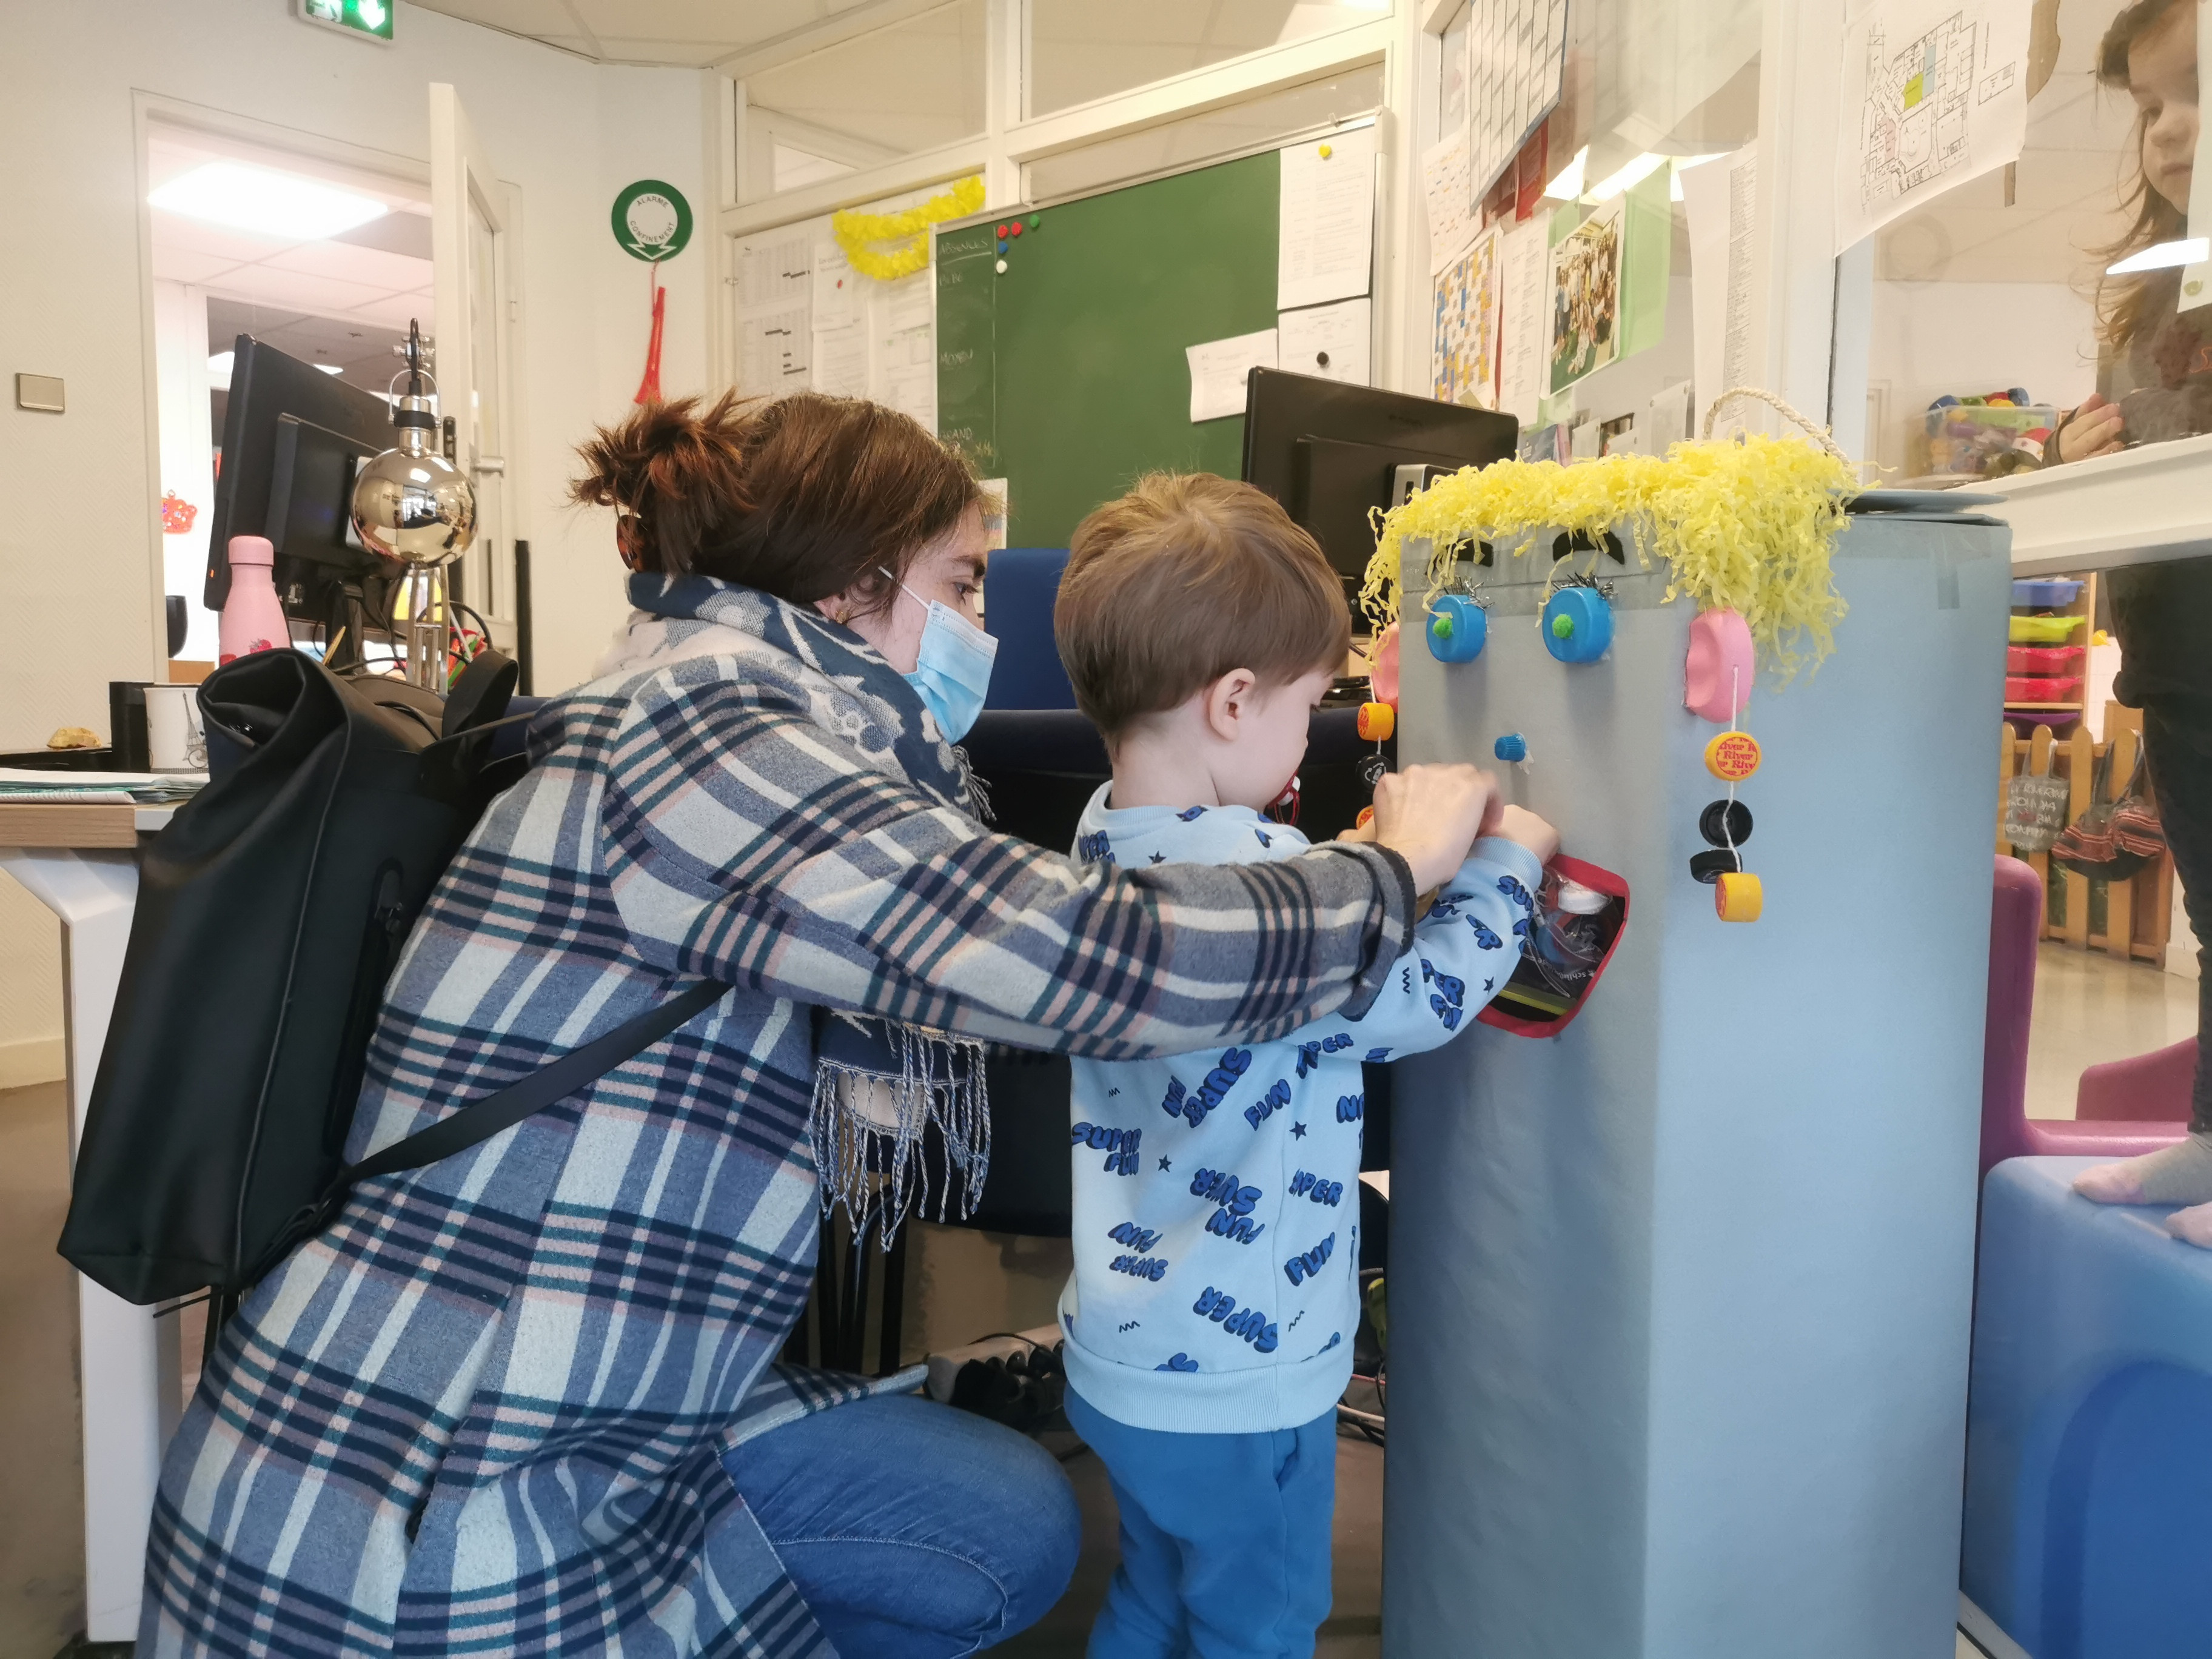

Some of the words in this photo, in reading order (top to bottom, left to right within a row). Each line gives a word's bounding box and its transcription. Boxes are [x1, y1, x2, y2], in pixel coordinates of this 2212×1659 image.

[637, 196, 669, 209] ALARME
[630, 220, 674, 243] CONFINEMENT
[1724, 750, 1754, 760] River
[1732, 760, 1755, 769] Rive
[1244, 1079, 1292, 1131] FUN
[1071, 1122, 1142, 1155] SUPER
[1104, 1152, 1140, 1176] FUN
[1107, 1221, 1164, 1254] FUN
[1204, 1207, 1265, 1245] FUN
[1109, 1255, 1168, 1282] SUPER
[1284, 1232, 1335, 1287] FUN
[1193, 1286, 1278, 1353] SUPER
